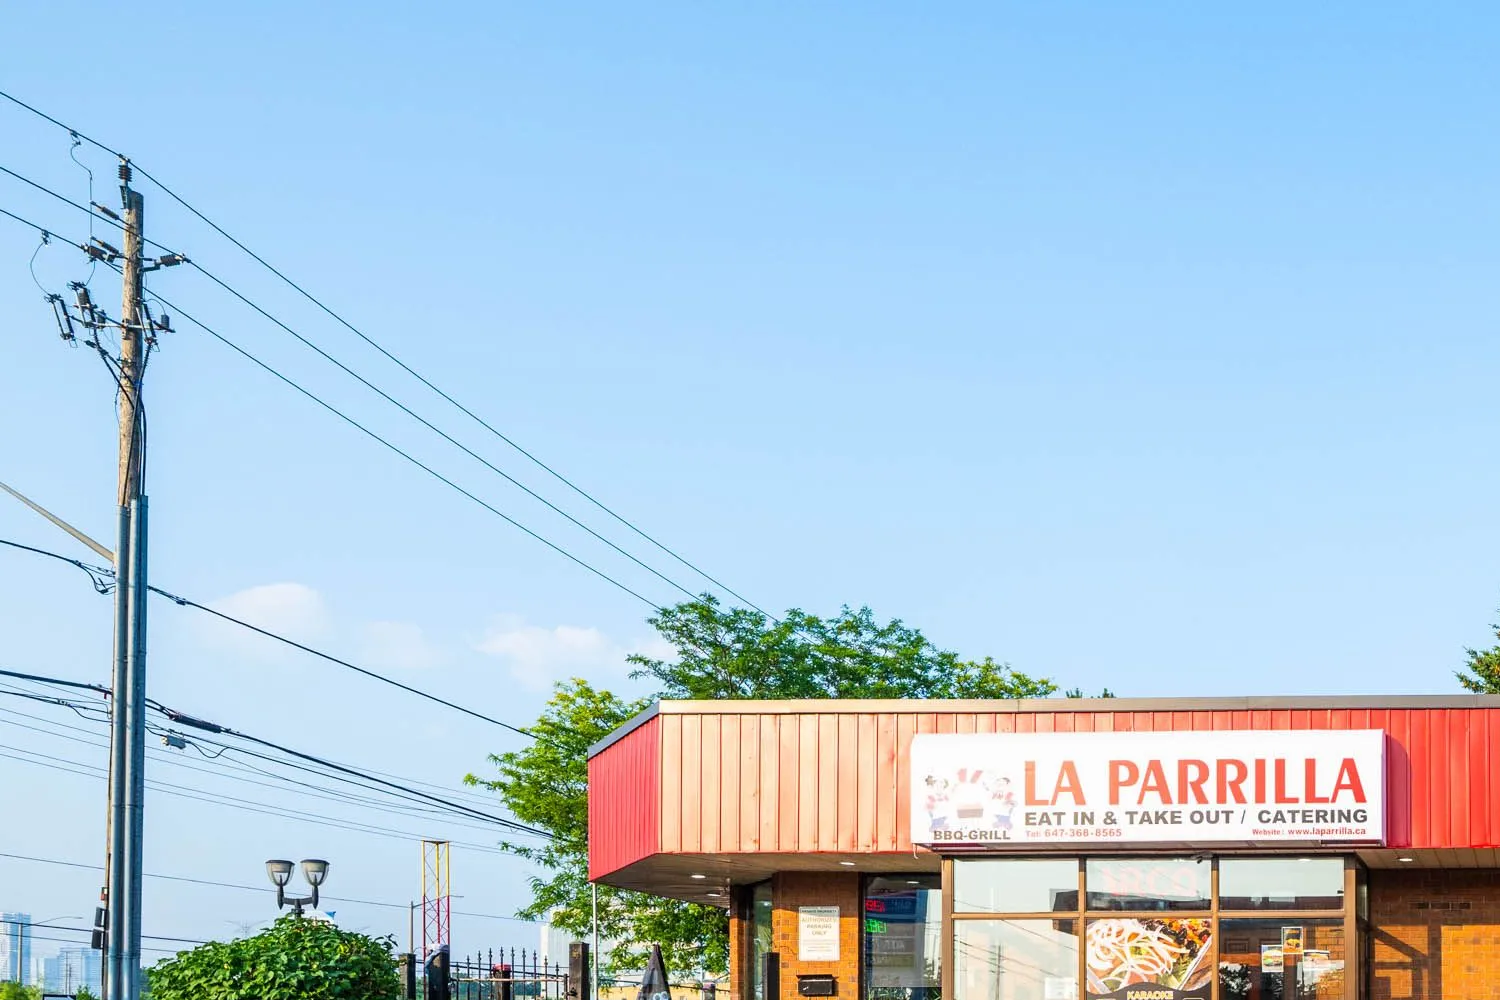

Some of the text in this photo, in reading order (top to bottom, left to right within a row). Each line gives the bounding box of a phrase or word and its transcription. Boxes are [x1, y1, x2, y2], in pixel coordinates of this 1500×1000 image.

[1024, 758, 1367, 806] LA PARRILLA
[1024, 811, 1066, 826] EAT
[1073, 811, 1095, 826] IN
[1103, 811, 1118, 826] &
[1125, 810, 1182, 826] TAKE
[1189, 809, 1234, 825] OUT
[1257, 809, 1368, 824] CATERING
[933, 830, 1011, 841] BBQ-GRILL
[1045, 828, 1122, 838] 647-368-8565
[1288, 827, 1366, 838] www.laparrilla.ca
[1126, 990, 1174, 1000] KARAOKE
